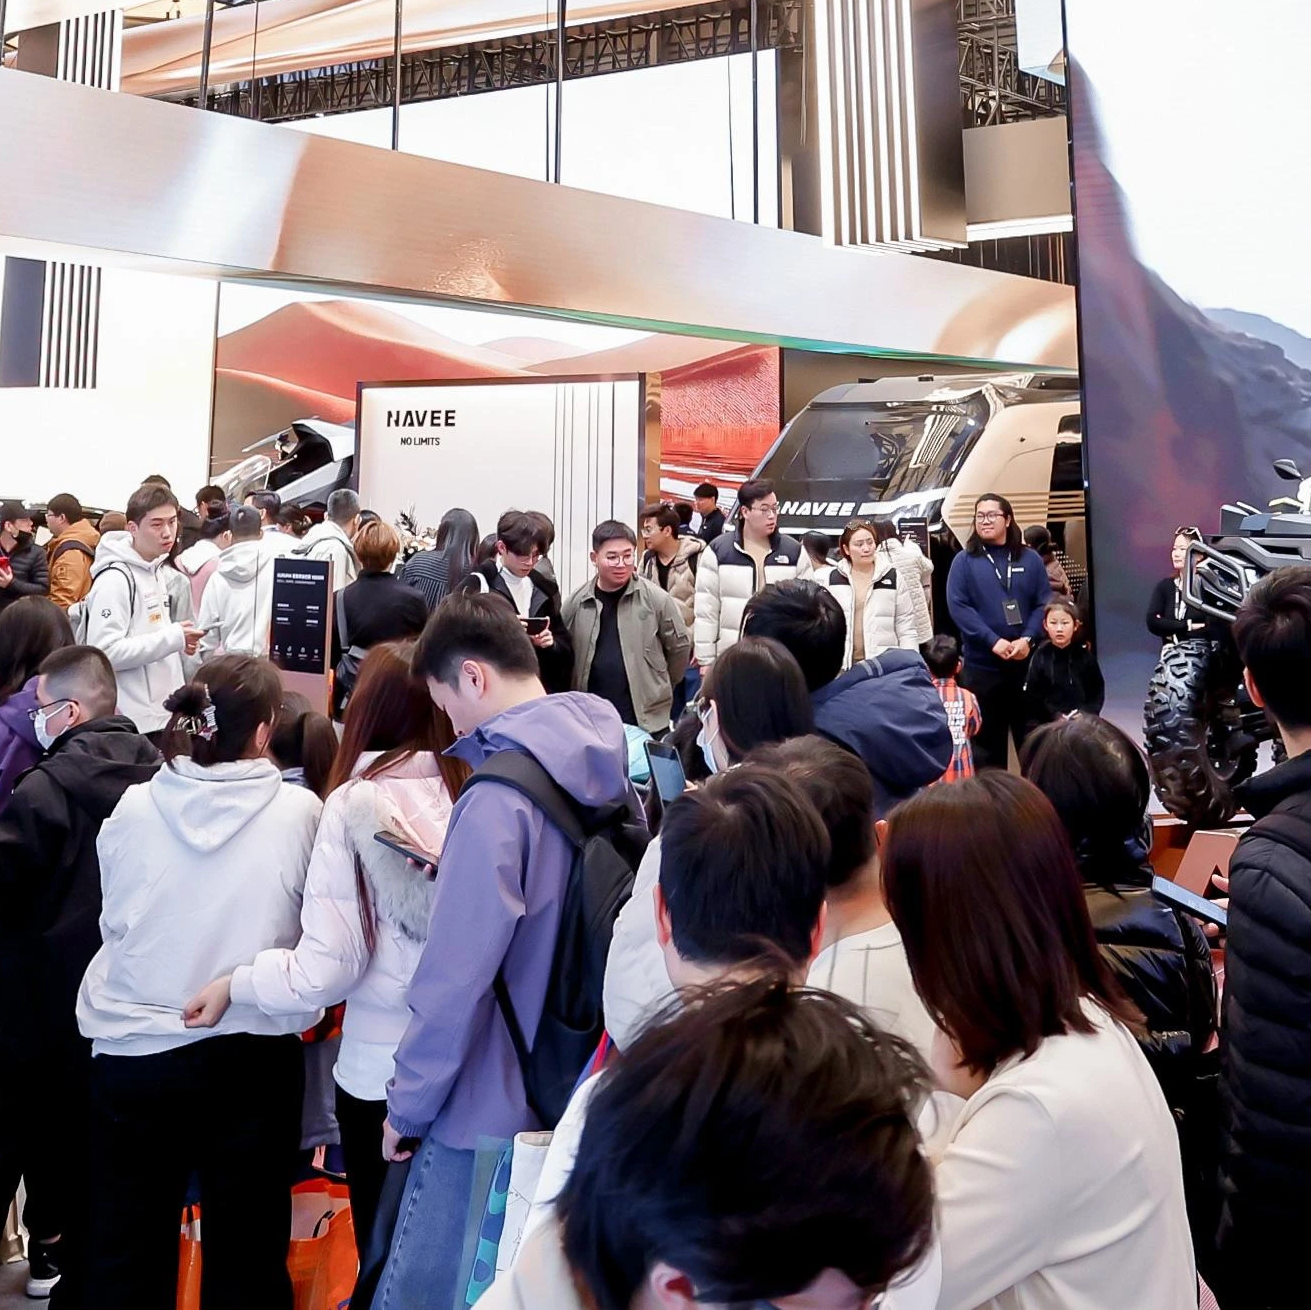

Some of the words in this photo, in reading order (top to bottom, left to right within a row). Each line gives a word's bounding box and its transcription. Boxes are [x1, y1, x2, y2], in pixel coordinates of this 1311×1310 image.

[386, 410, 456, 427] NAVEE
[400, 437, 412, 446] NO
[413, 437, 440, 446] LIMITS
[780, 501, 856, 516] NAVEE
